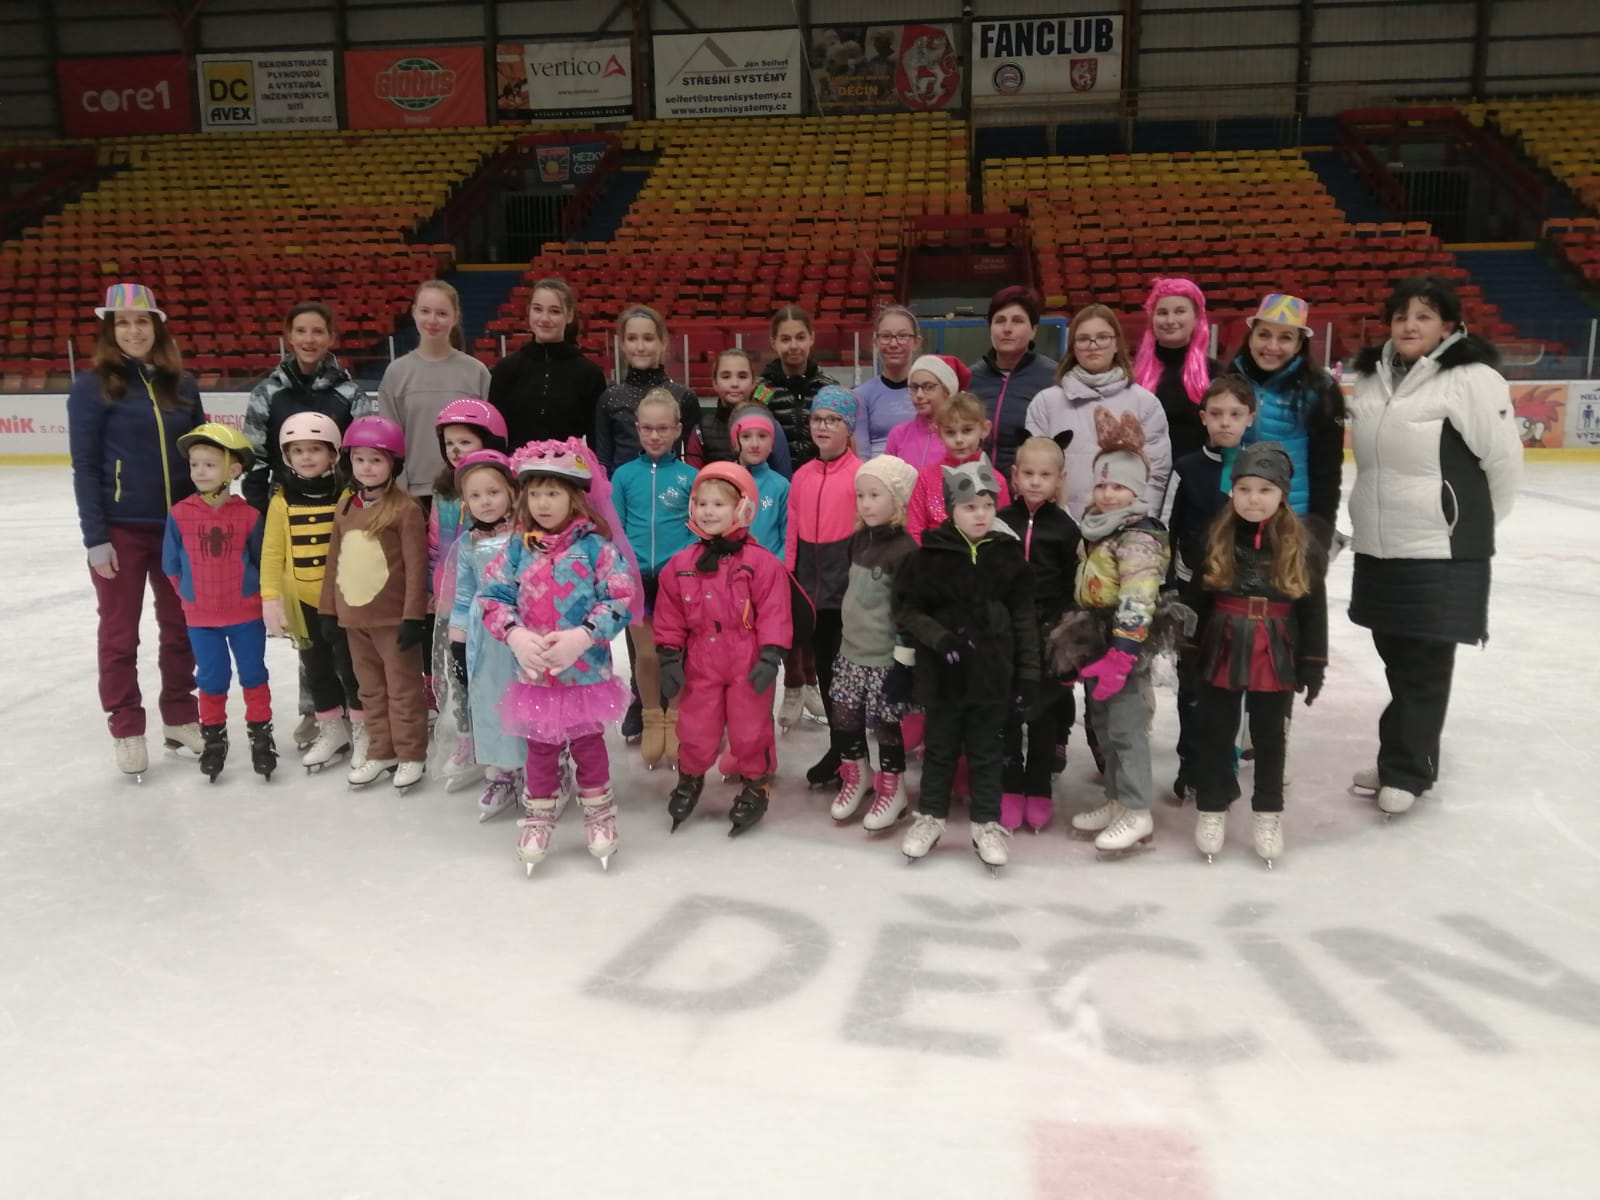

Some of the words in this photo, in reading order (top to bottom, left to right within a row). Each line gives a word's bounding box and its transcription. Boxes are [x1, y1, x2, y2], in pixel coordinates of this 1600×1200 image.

[980, 18, 1113, 58] FANCLUB
[257, 59, 329, 69] REKONSTRUKCE
[530, 57, 601, 77] vertico
[744, 60, 759, 68] Jan
[761, 58, 789, 67] Seifert
[682, 73, 730, 86] STŘEŠNÍ
[734, 72, 787, 84] SYSTÉMY
[82, 80, 171, 112] core1
[209, 78, 249, 102] DC
[665, 91, 792, 103] seifert@stresnisystemy.cz
[211, 106, 252, 122] AVEX
[671, 103, 788, 115] www.stresnisystemy.cz
[572, 162, 596, 174] ČES
[580, 893, 1600, 1064] DĚČÍN
